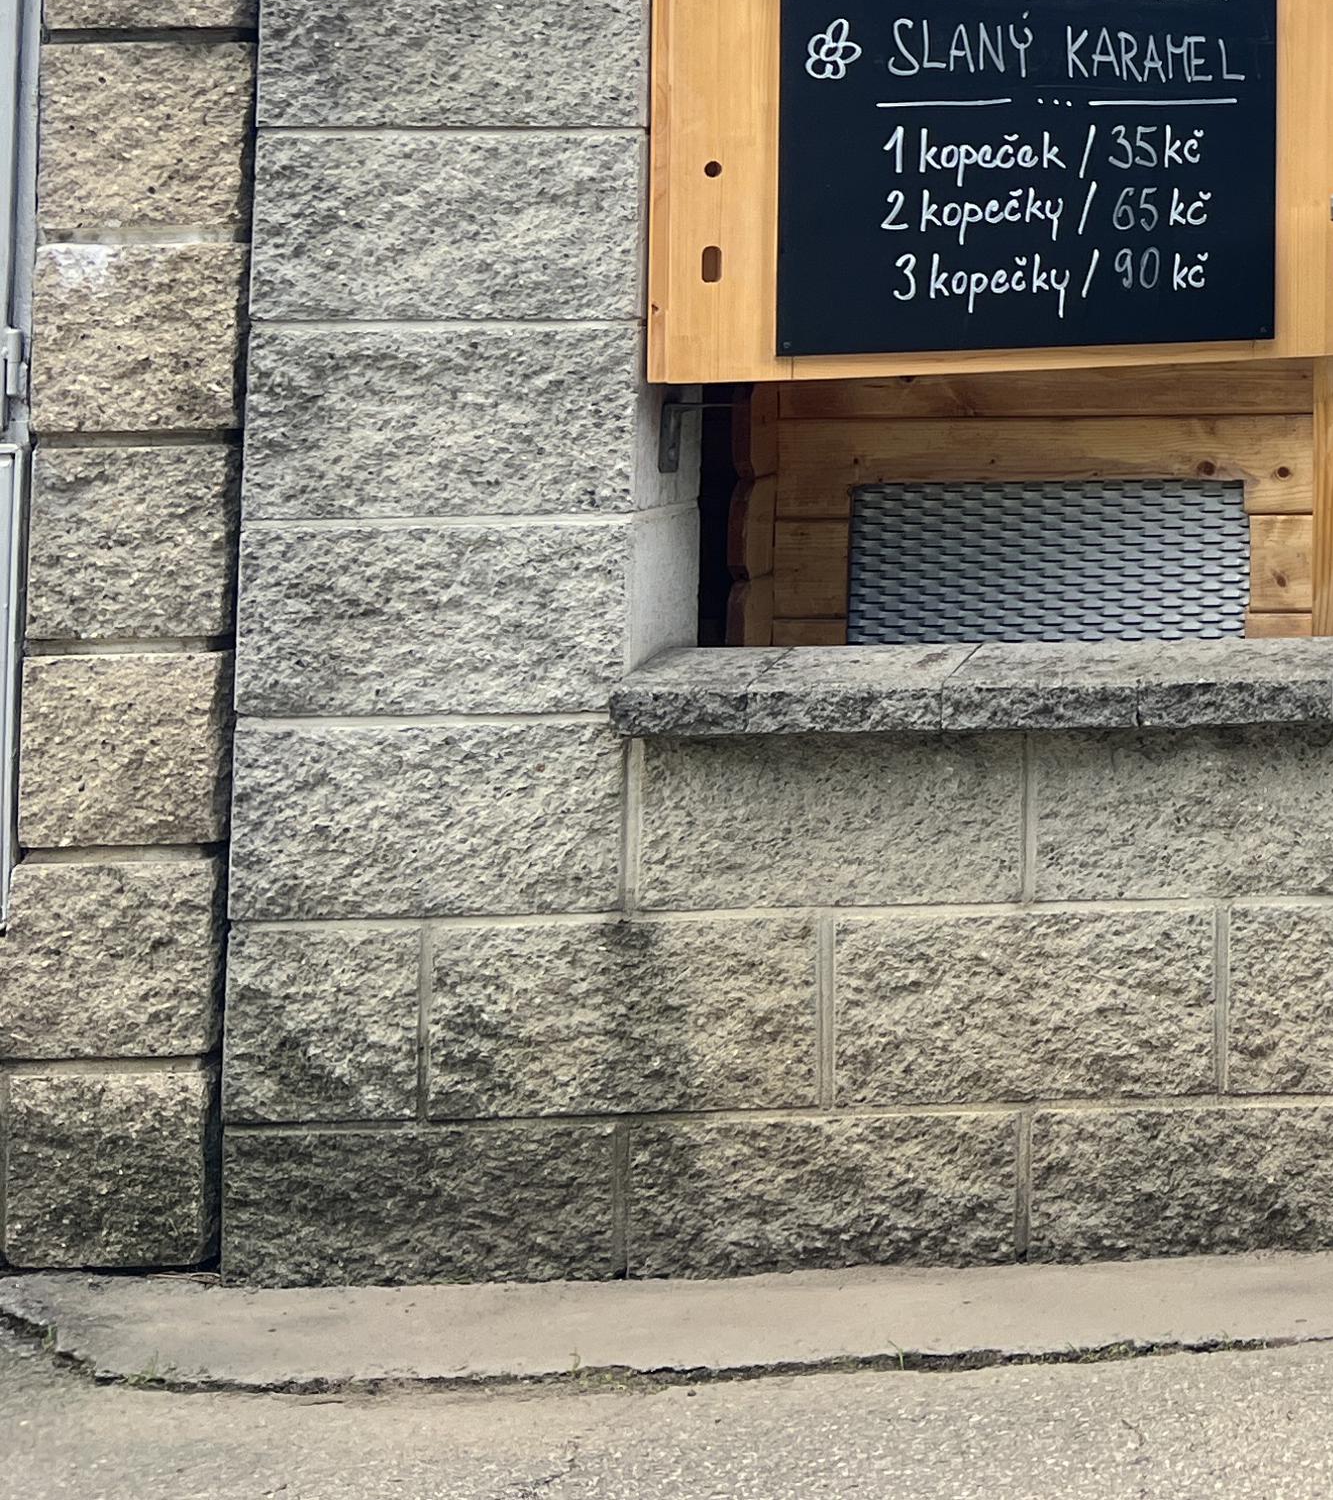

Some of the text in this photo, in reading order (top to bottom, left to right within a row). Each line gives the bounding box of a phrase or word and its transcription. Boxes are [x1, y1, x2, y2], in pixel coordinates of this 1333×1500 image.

[887, 10, 1246, 83] SLANÝ KARAMEL
[882, 126, 904, 174] 1
[919, 128, 1066, 187] kopeček
[881, 188, 909, 231] 2
[921, 188, 1063, 246] kopečky
[893, 253, 917, 301] 3
[929, 253, 1070, 318] kopečky
